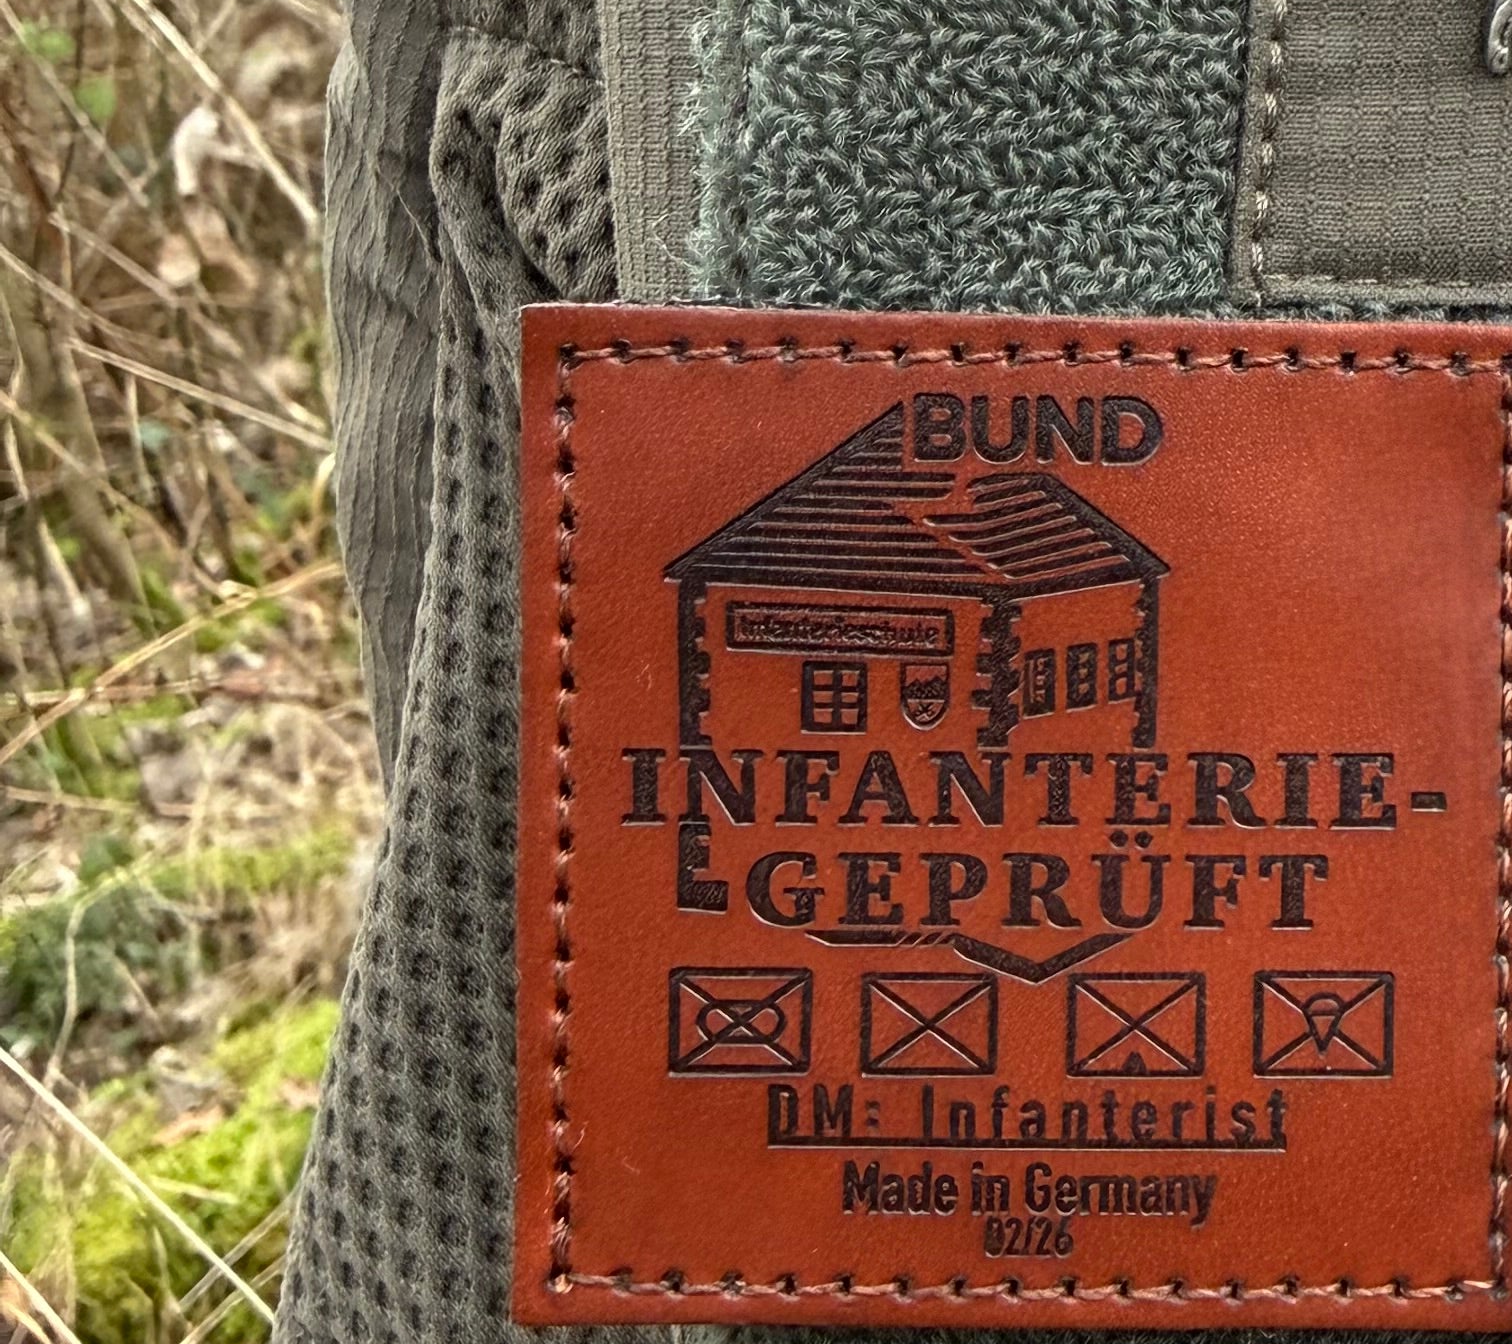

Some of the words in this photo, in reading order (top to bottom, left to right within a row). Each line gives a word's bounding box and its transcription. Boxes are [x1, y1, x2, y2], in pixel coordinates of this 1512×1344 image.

[914, 393, 1163, 465] BUND
[621, 748, 1448, 830] INFANTERIE-
[744, 828, 1330, 931] GEPRÜFT
[768, 1084, 880, 1142] DM:
[921, 1085, 1287, 1147] Infanterist
[843, 1161, 958, 1215] Made
[971, 1162, 1010, 1215] in
[1024, 1162, 1218, 1229] Germany
[983, 1217, 1075, 1256] 02/26
